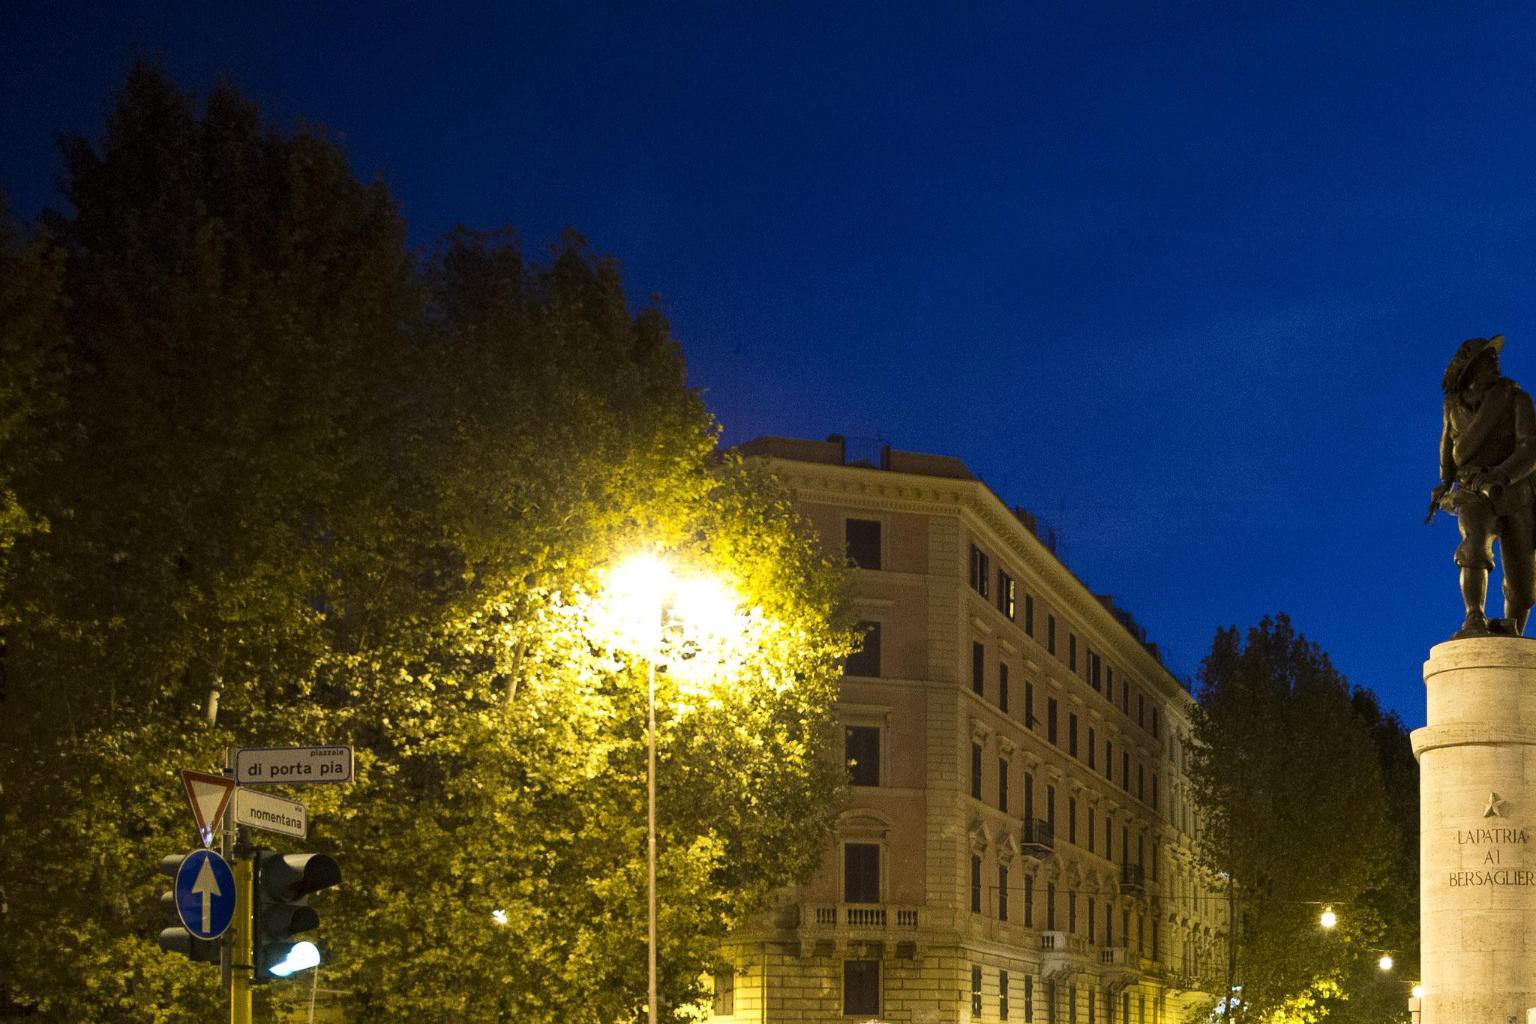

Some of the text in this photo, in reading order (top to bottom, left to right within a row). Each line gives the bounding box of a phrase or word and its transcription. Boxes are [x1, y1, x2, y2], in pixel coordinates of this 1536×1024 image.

[310, 749, 344, 757] piazzale
[248, 761, 343, 777] di porta pia
[250, 808, 302, 829] nomentana
[1484, 850, 1500, 864] AI
